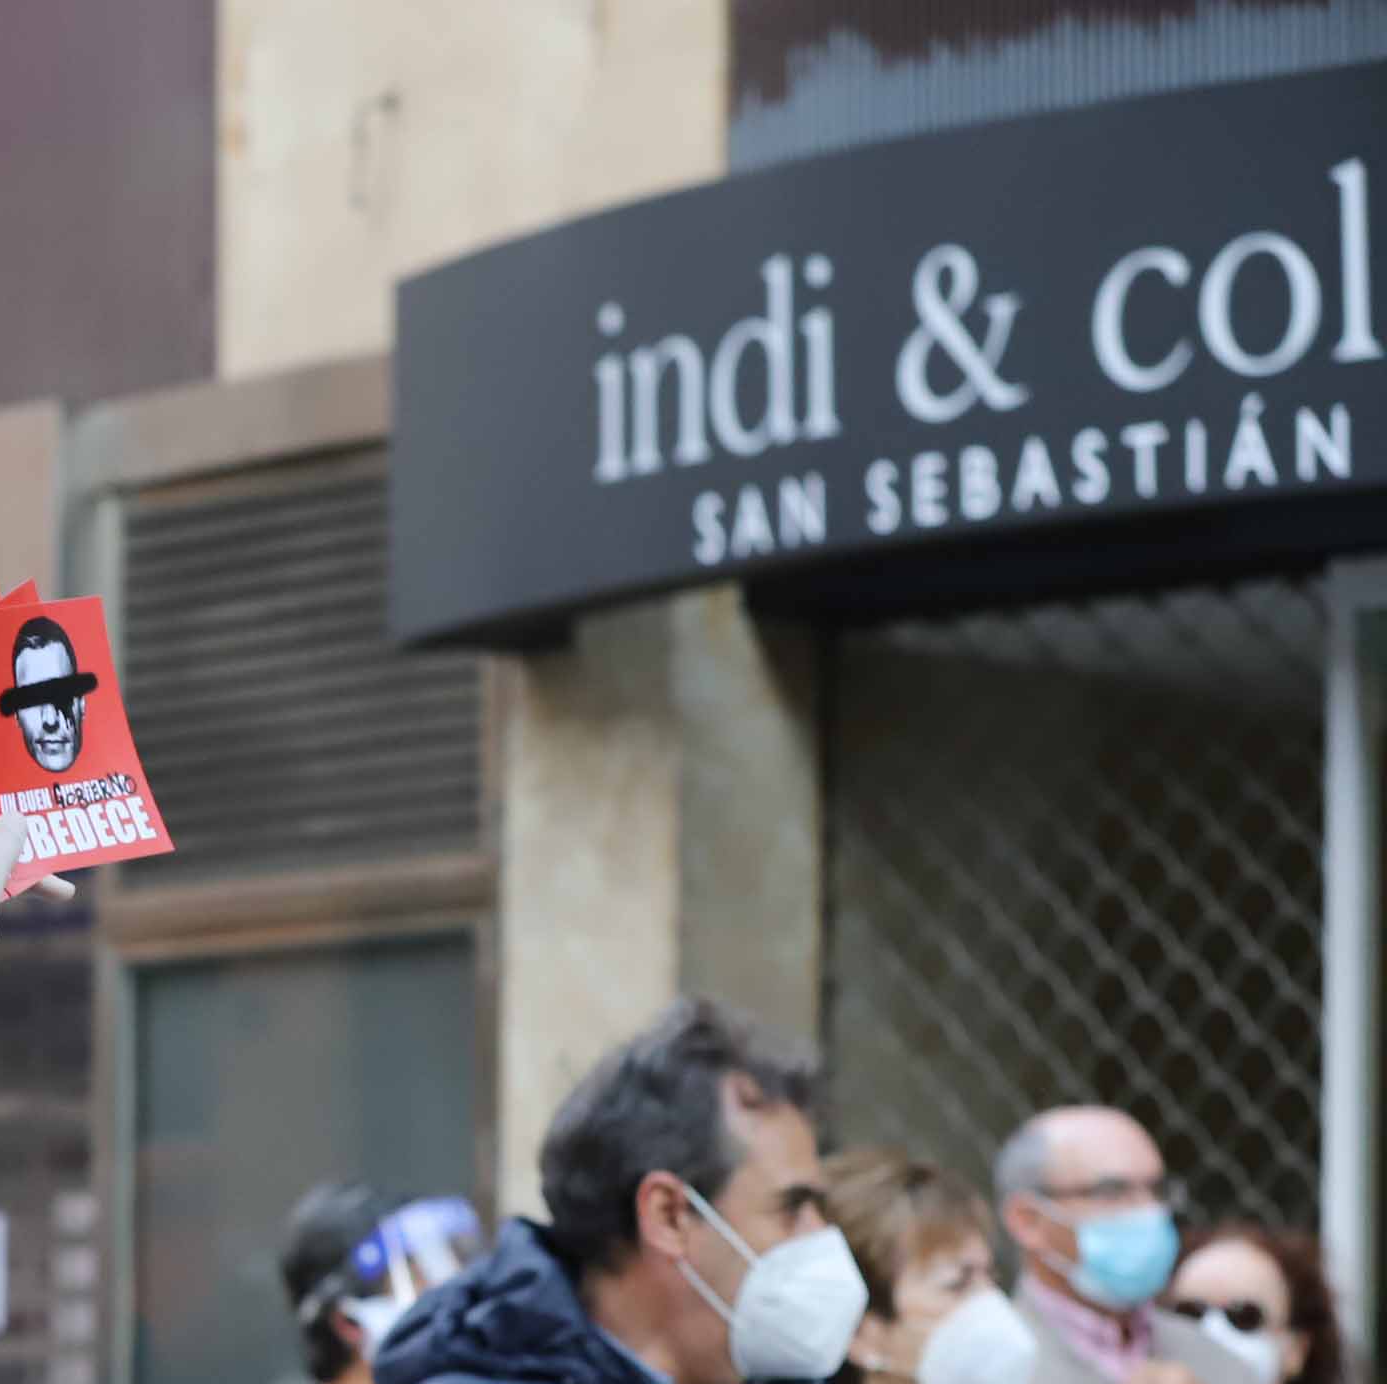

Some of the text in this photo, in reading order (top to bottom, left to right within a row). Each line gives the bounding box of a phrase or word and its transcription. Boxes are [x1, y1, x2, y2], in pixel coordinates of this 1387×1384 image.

[593, 156, 1385, 483] indi & col
[691, 391, 1353, 566] SAN SEBASTIÁN
[17, 787, 53, 814] BUEN
